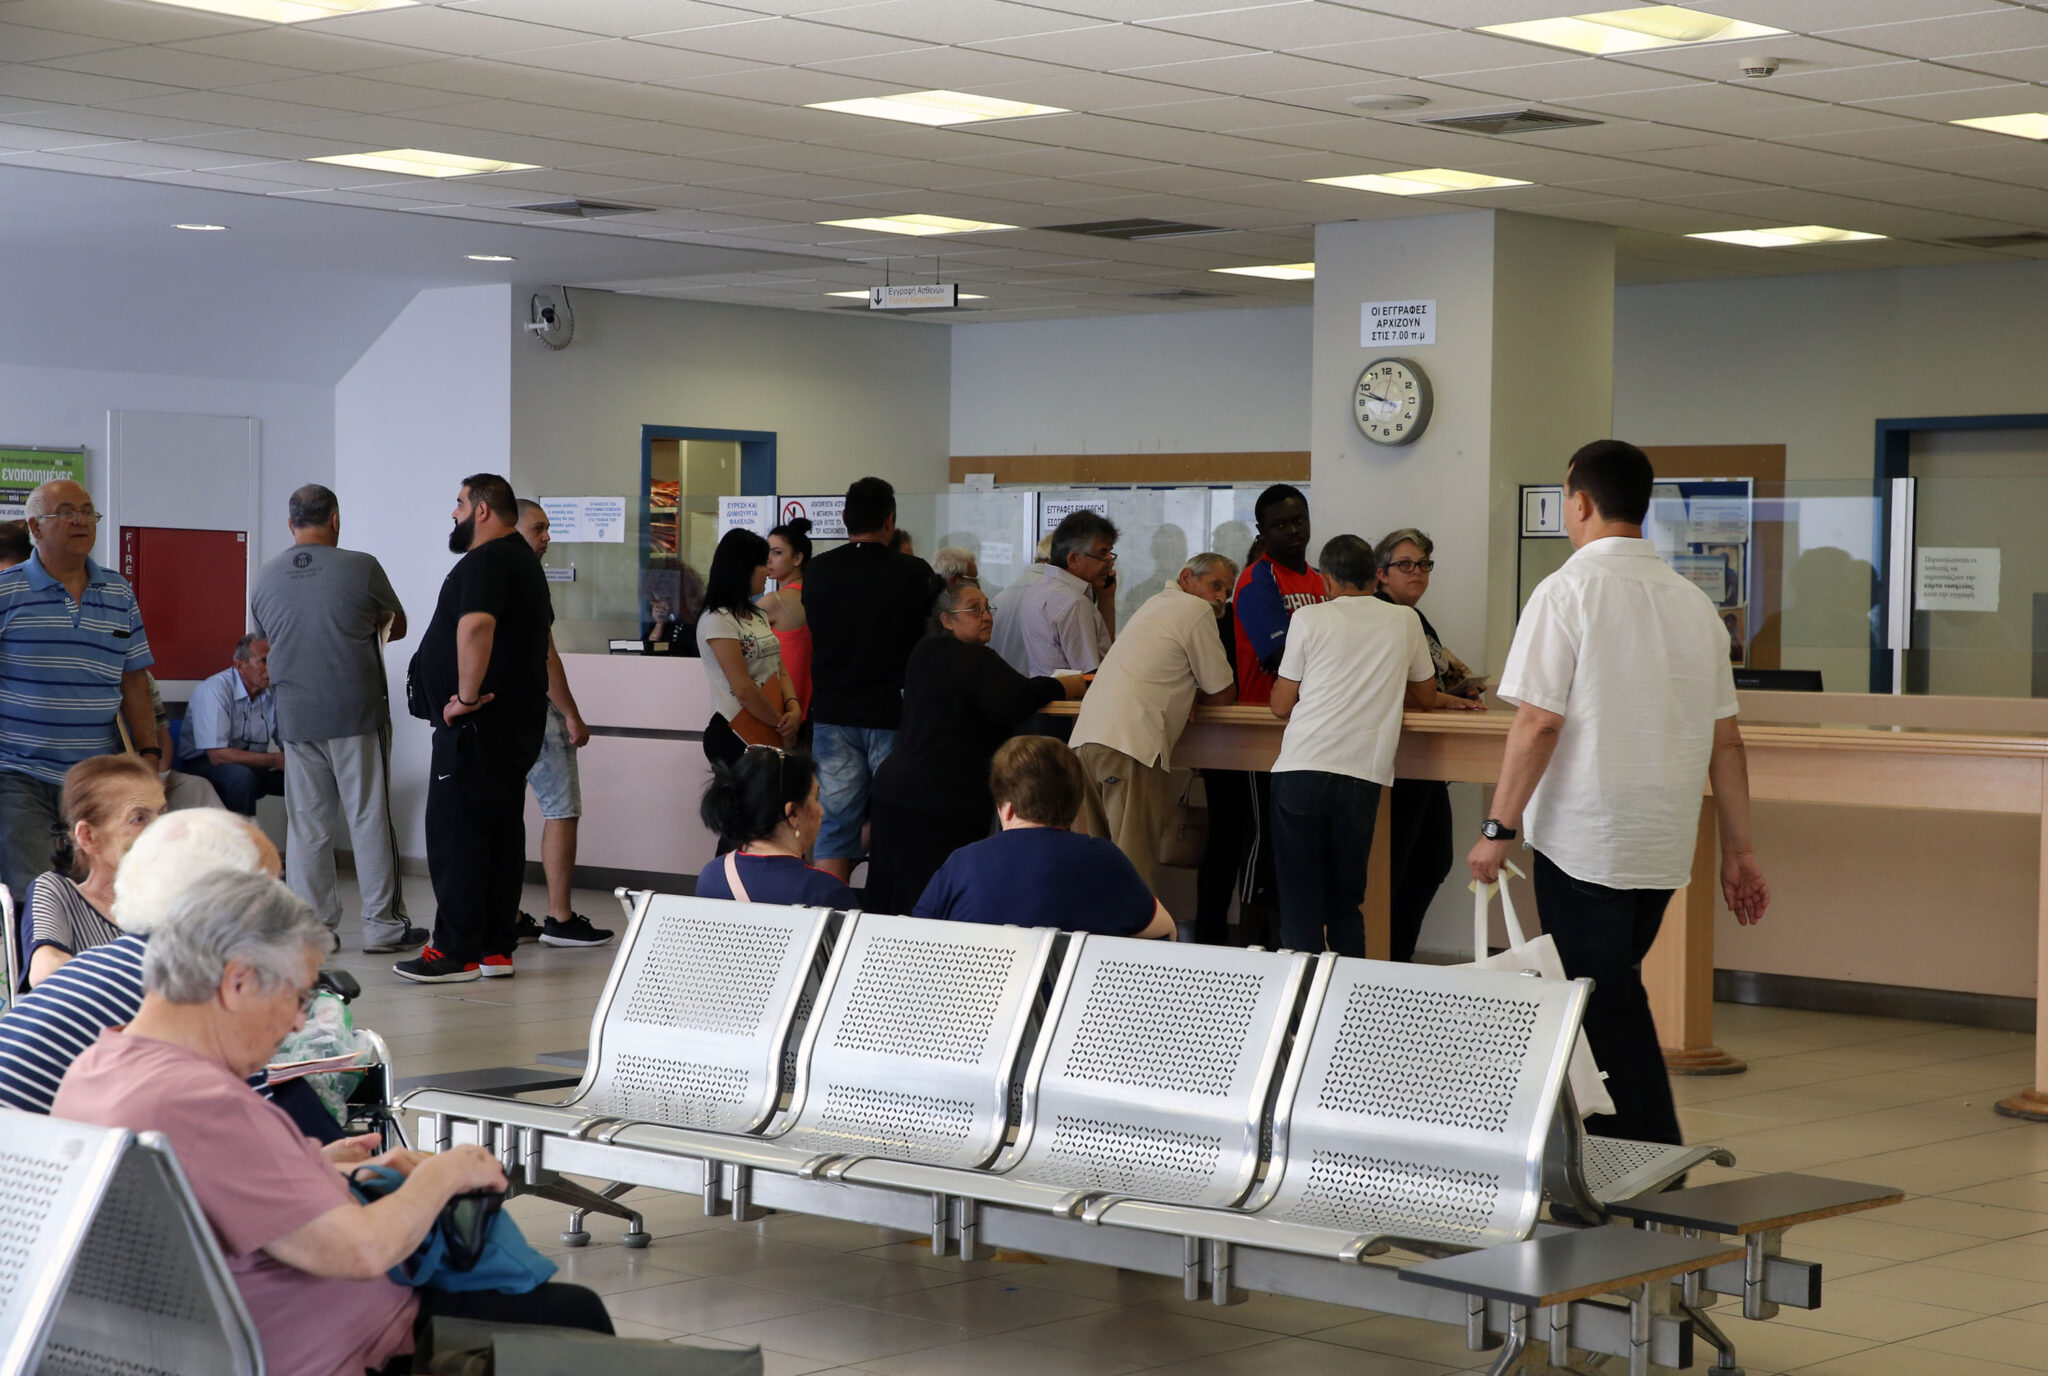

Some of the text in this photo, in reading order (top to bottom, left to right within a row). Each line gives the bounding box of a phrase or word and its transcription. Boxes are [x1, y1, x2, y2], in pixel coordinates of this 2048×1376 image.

[1371, 305, 1427, 316] ΟΙ ΕΓΓΡΑΦΕΣ
[1376, 318, 1421, 328] ΑΡΧΙΖΟΥΝ
[1372, 331, 1390, 340] ΣΤΙΣ
[1392, 331, 1409, 340] 7.00
[1381, 367, 1392, 375] 12
[1397, 371, 1402, 379] 1
[1359, 399, 1365, 407] 9
[1371, 424, 1377, 432] 7
[1396, 423, 1403, 431] 5
[1384, 428, 1390, 436] 6
[1047, 505, 1074, 514] ΕΓΓΡΑΦΕΣ
[125, 532, 133, 575] FIRE
